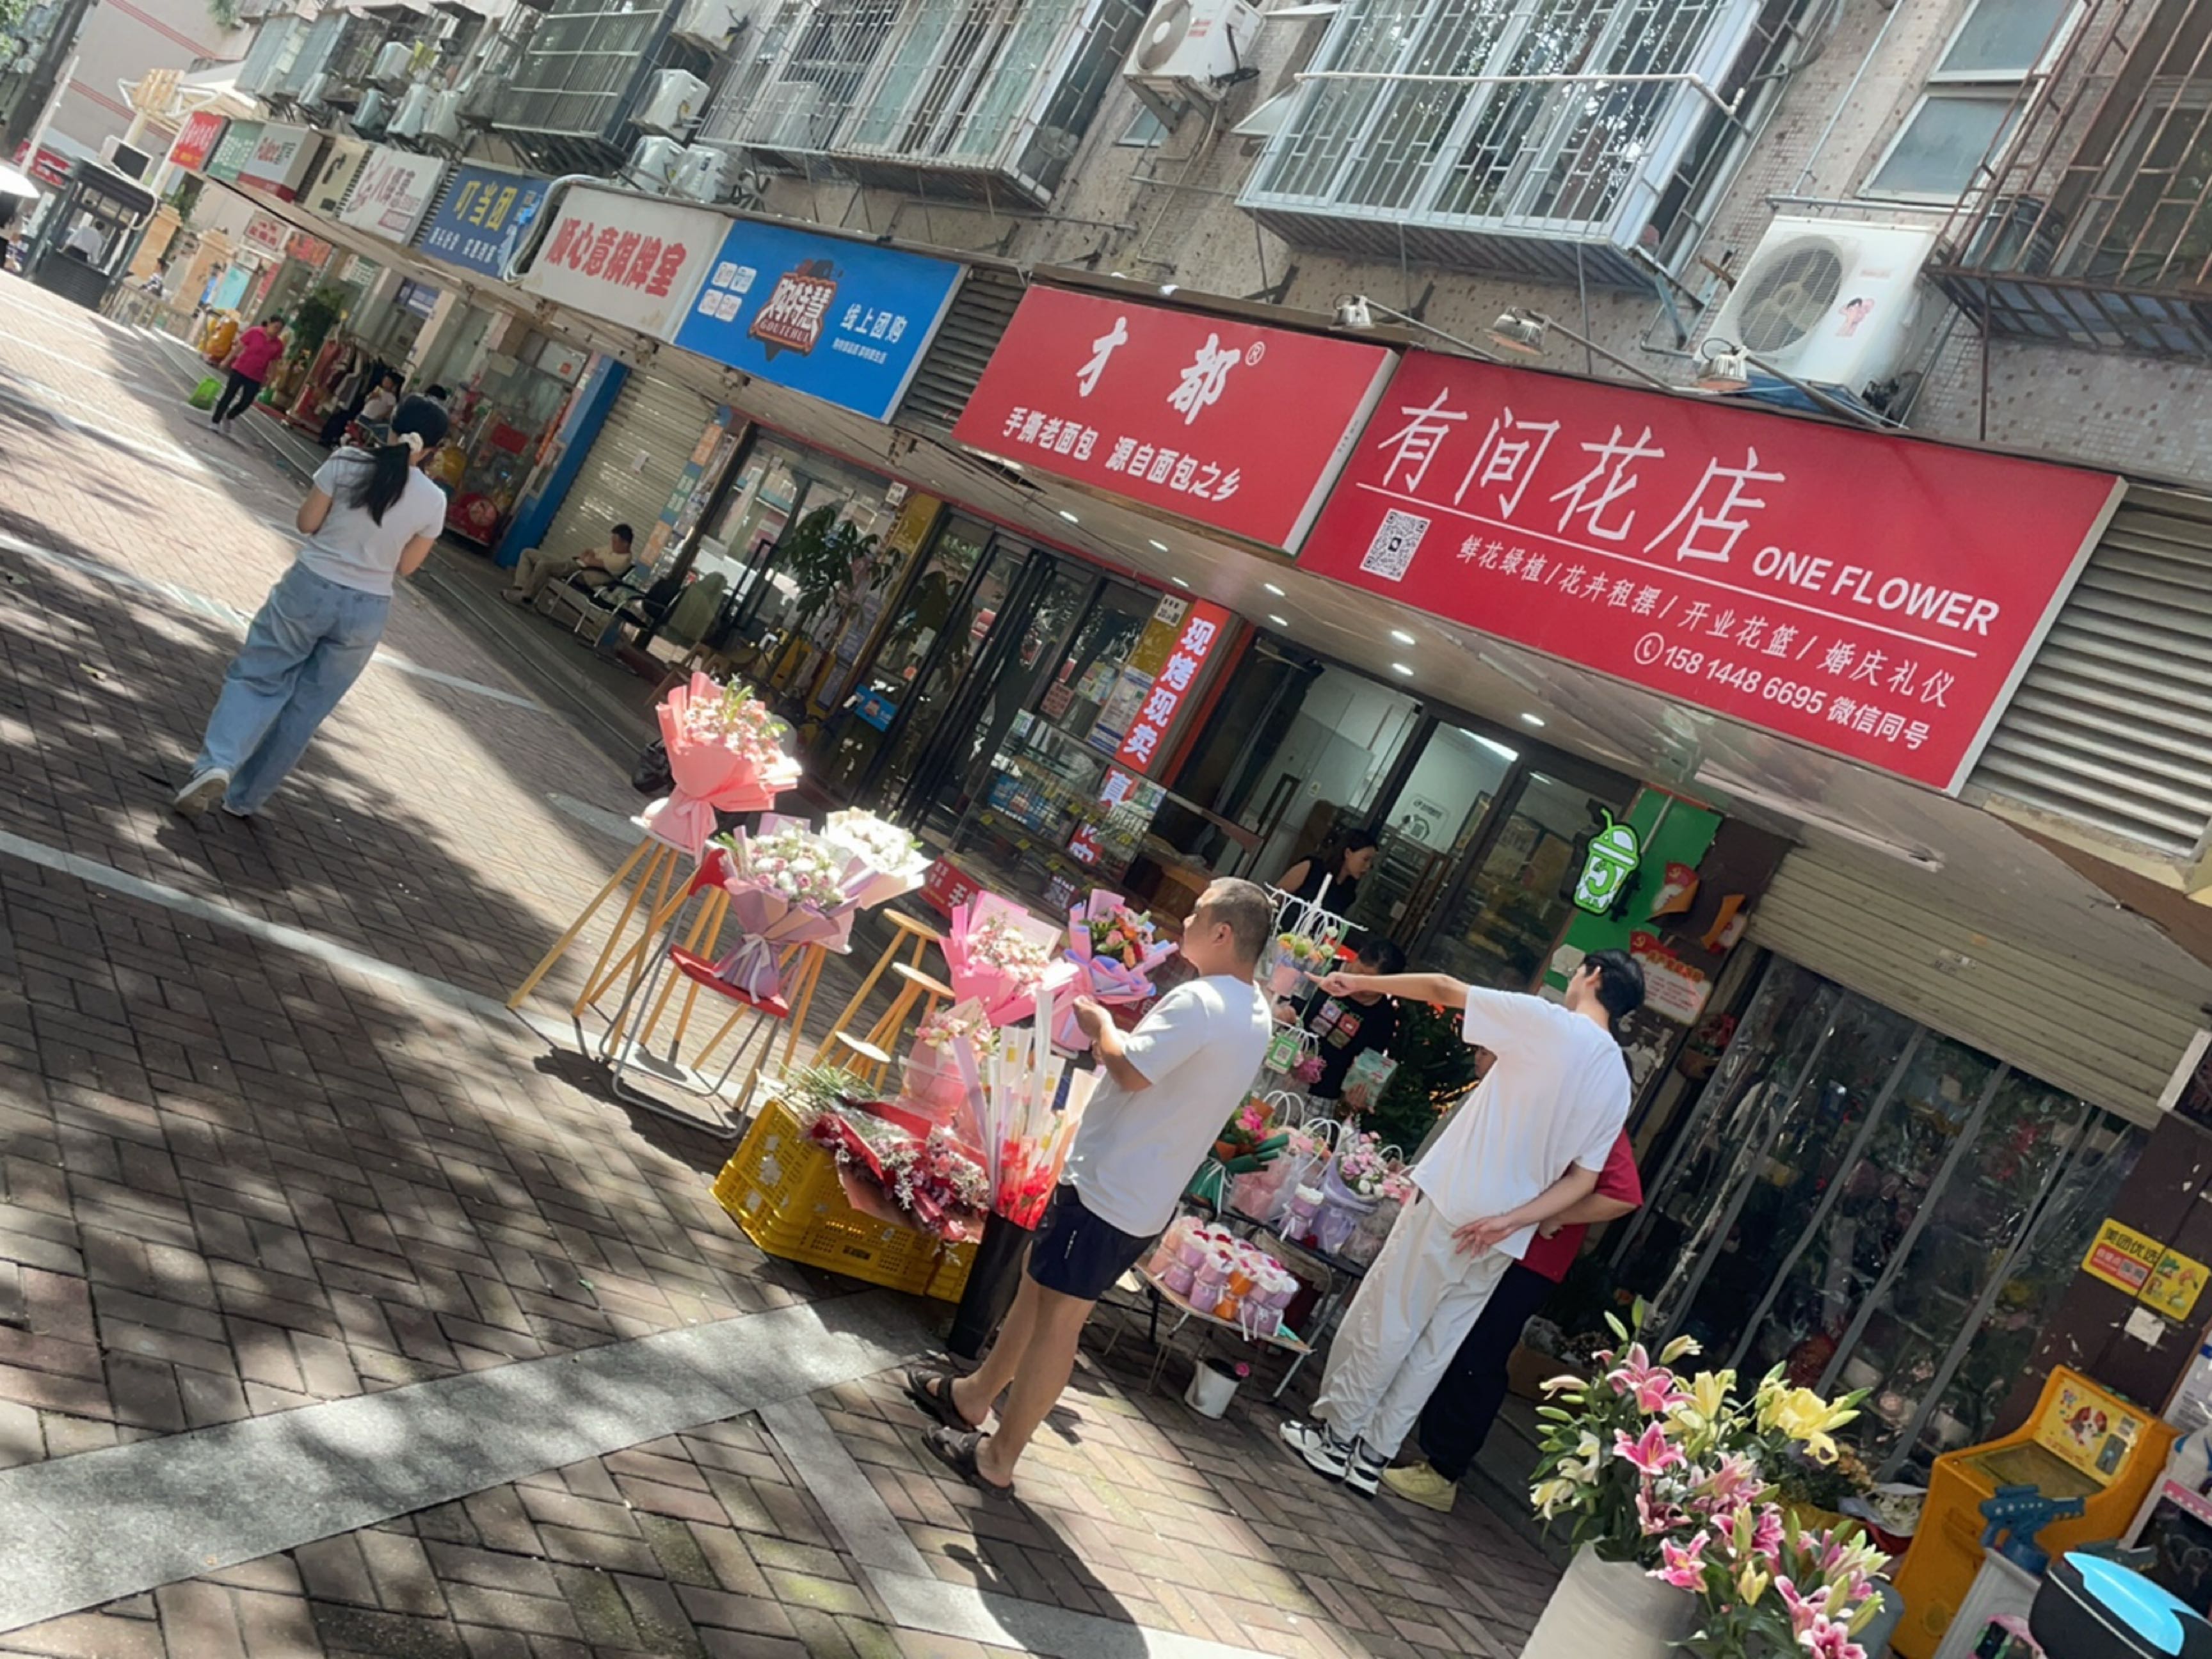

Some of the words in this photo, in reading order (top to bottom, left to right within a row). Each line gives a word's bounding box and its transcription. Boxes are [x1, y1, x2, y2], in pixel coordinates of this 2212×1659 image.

[544, 218, 687, 298] 顺心意棋牌室
[755, 277, 832, 332] 购特慧
[840, 303, 908, 344] 线上团购
[1003, 406, 1099, 461] 手撕老面包
[1106, 436, 1240, 501] 源自面包之乡
[1378, 387, 1786, 563] 有间花店
[1752, 546, 1839, 592] ONE
[1831, 565, 2000, 636] FLOWER
[1123, 617, 1216, 764] 现烤现卖
[1664, 645, 1704, 674] 158
[1707, 659, 1761, 694] 1448
[1762, 677, 1828, 714] 6695
[1827, 696, 1930, 750] 微信同号
